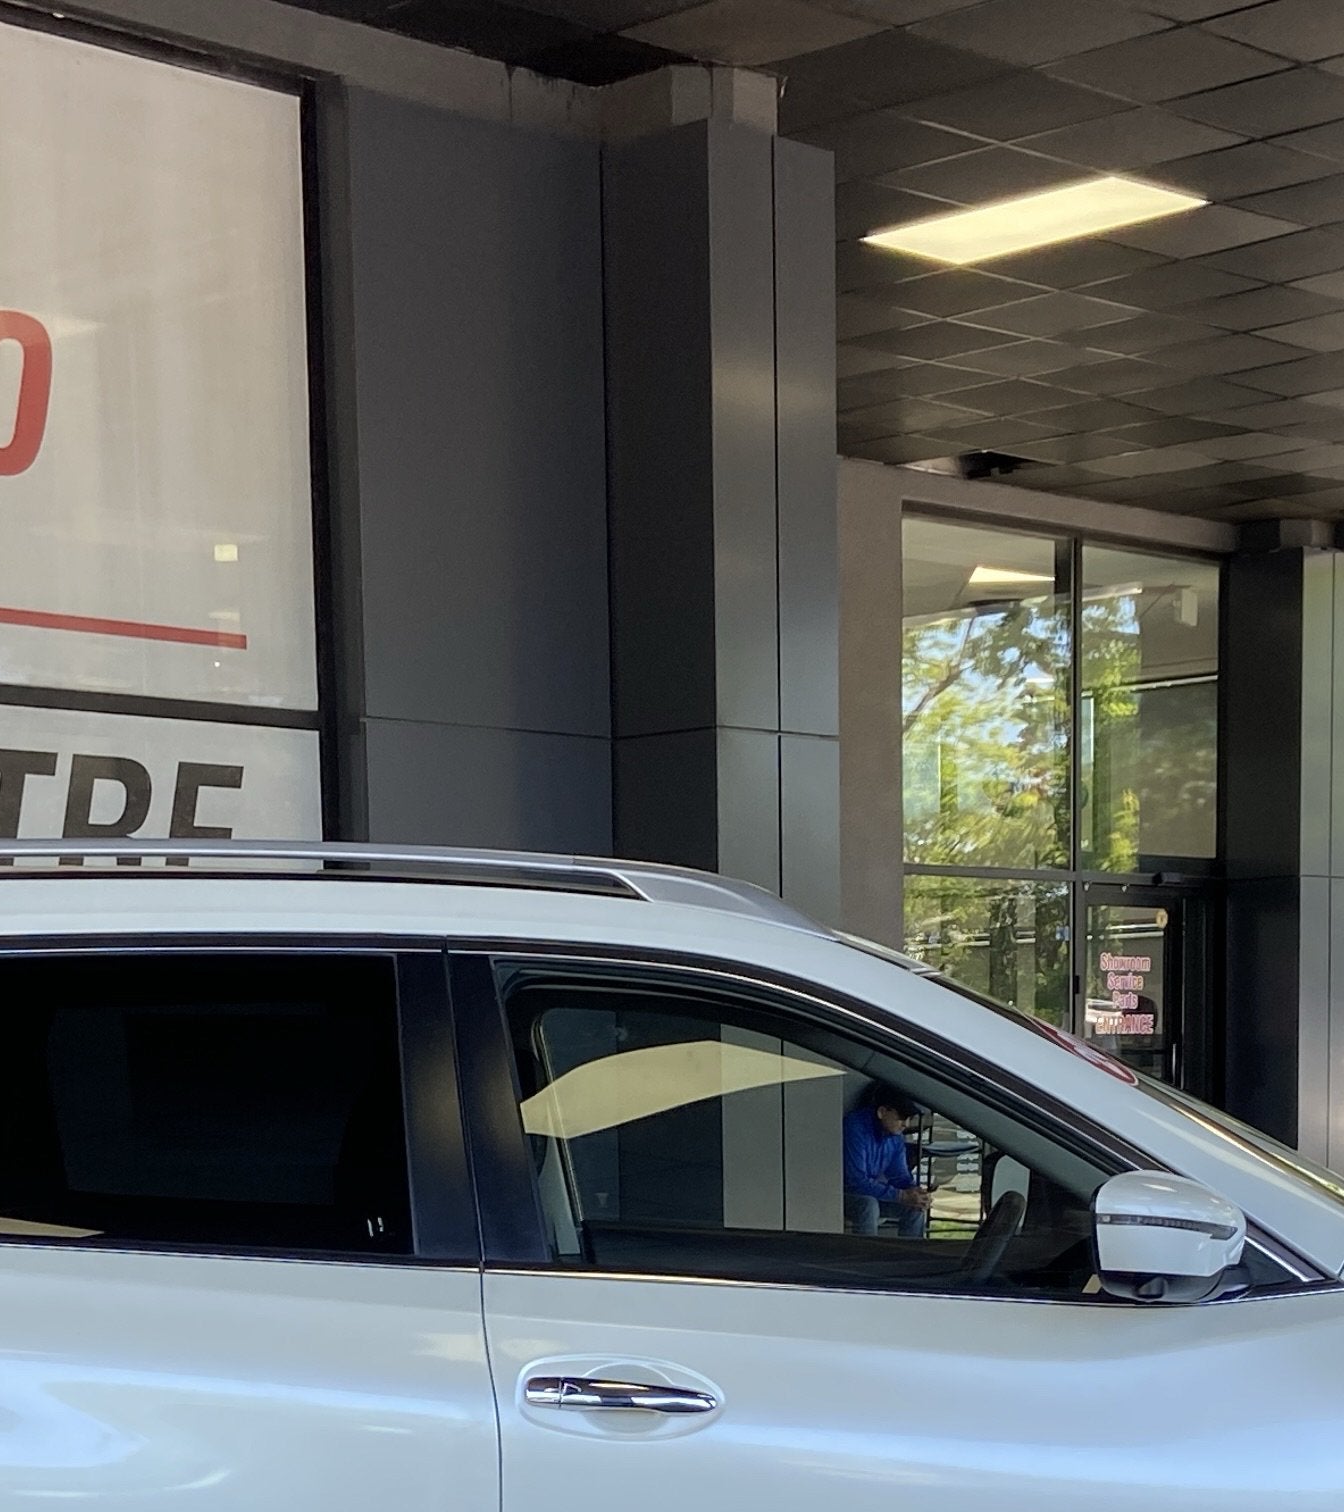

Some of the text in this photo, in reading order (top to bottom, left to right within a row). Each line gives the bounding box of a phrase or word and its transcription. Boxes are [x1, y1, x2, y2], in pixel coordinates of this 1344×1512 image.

[1099, 952, 1152, 972] Showroom
[1106, 971, 1145, 991] Service
[1111, 991, 1139, 1010] Parts
[1095, 1013, 1154, 1035] ENTRANCE
